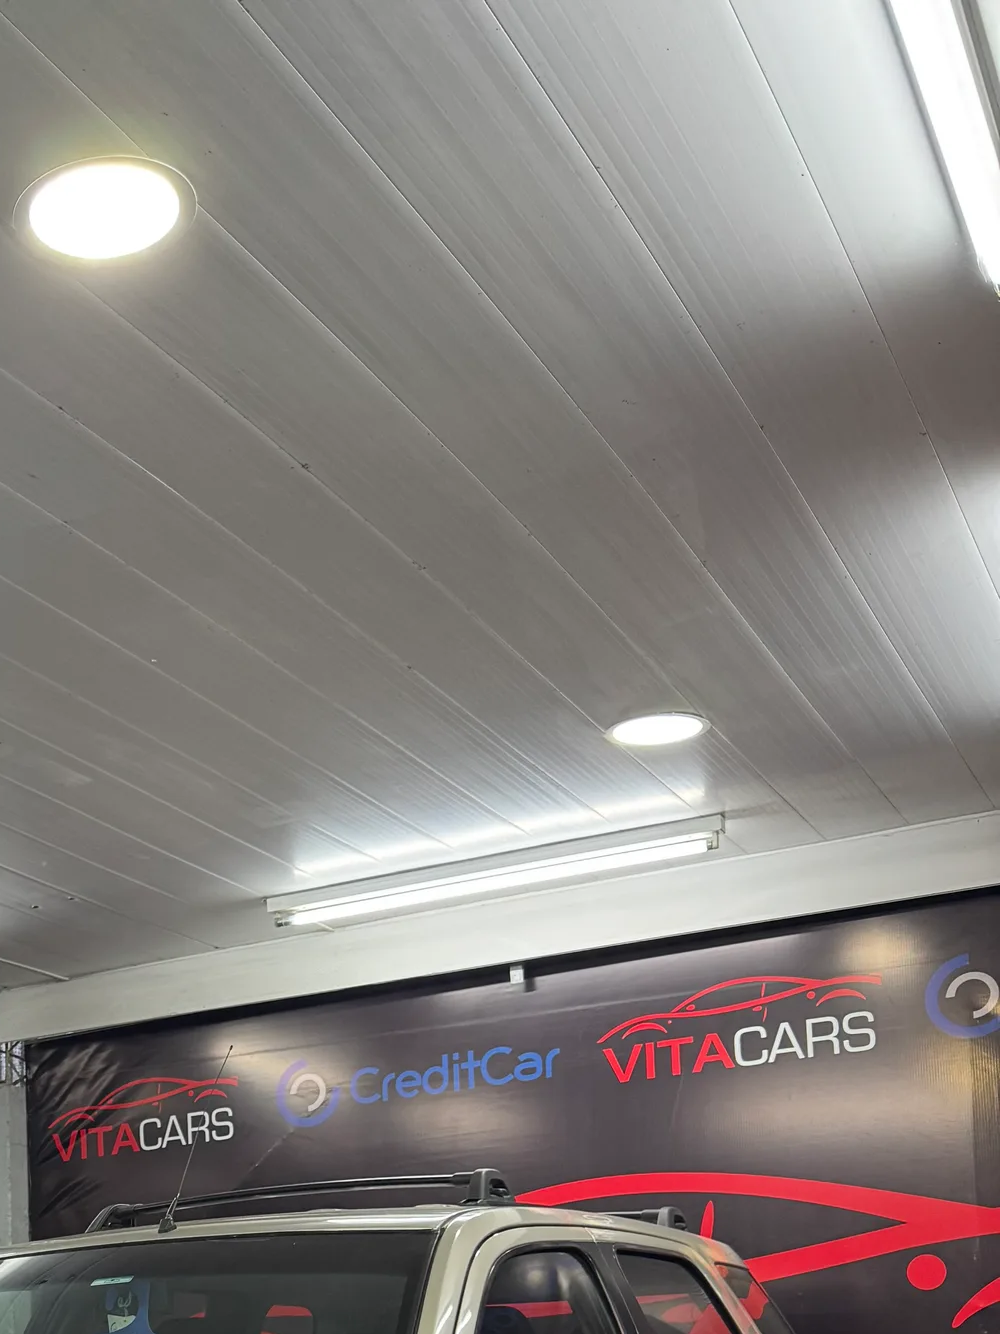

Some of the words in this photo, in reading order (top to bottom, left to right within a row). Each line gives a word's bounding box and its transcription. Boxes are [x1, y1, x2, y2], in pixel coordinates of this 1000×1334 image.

[350, 1046, 561, 1105] CreditCar
[602, 1011, 877, 1084] VITACARS
[51, 1106, 235, 1163] VITACARS
